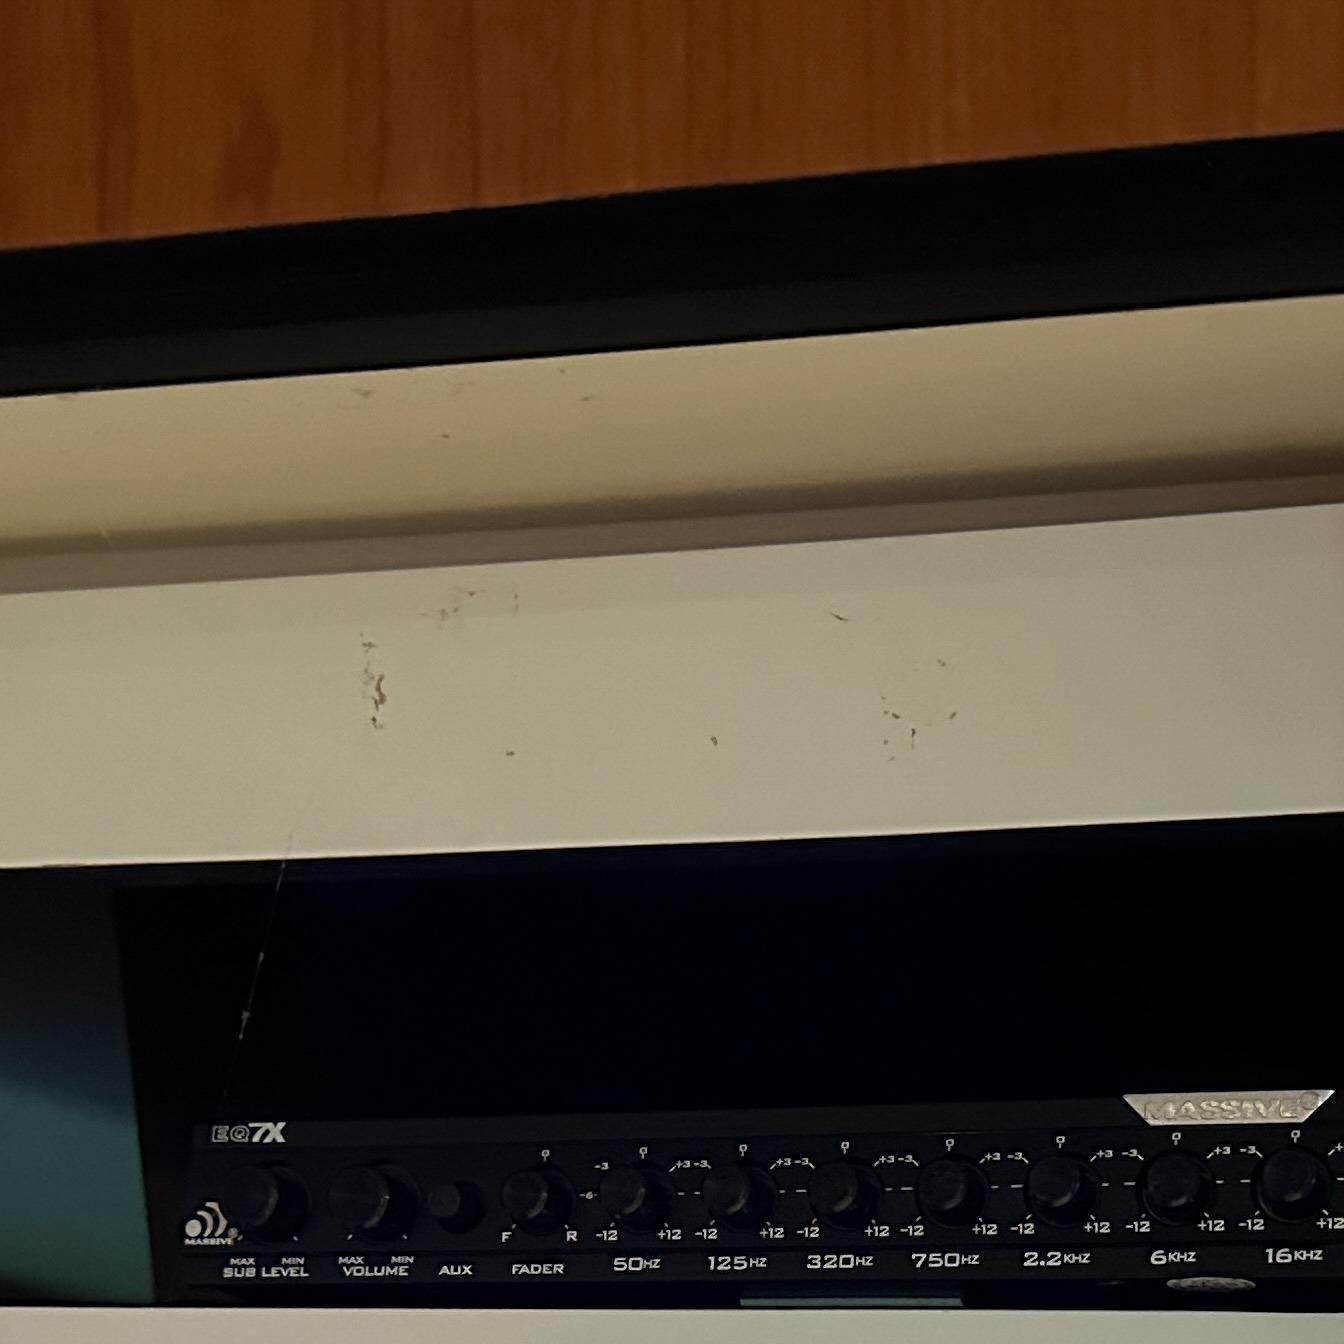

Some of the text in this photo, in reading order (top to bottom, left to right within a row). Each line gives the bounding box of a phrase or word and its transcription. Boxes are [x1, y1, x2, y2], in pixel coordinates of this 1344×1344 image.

[1144, 1100, 1298, 1120] MASSIVE
[212, 1122, 286, 1143] EQ7X
[1010, 1223, 1034, 1234] -12
[1084, 1222, 1110, 1233] +12
[1125, 1221, 1150, 1232] -12
[1197, 1220, 1225, 1231] +12
[1238, 1219, 1264, 1230] -12
[1316, 1218, 1344, 1229] +12
[694, 1229, 718, 1239] -12
[760, 1228, 784, 1238] +12
[796, 1227, 819, 1237] -12
[864, 1226, 889, 1236] +12
[900, 1225, 924, 1236] -12
[972, 1224, 997, 1235] +12
[502, 1232, 512, 1242] F
[566, 1231, 577, 1241] R
[595, 1230, 618, 1241] -12
[657, 1230, 681, 1240] +12
[230, 1257, 255, 1265] MAX
[282, 1256, 304, 1265] MIN
[338, 1256, 364, 1264] MAX
[391, 1255, 414, 1264] MIN
[223, 1267, 309, 1277] SUB LEVEL
[343, 1266, 409, 1276] VOLUME
[438, 1265, 472, 1275] AUX
[512, 1264, 564, 1275] FADER
